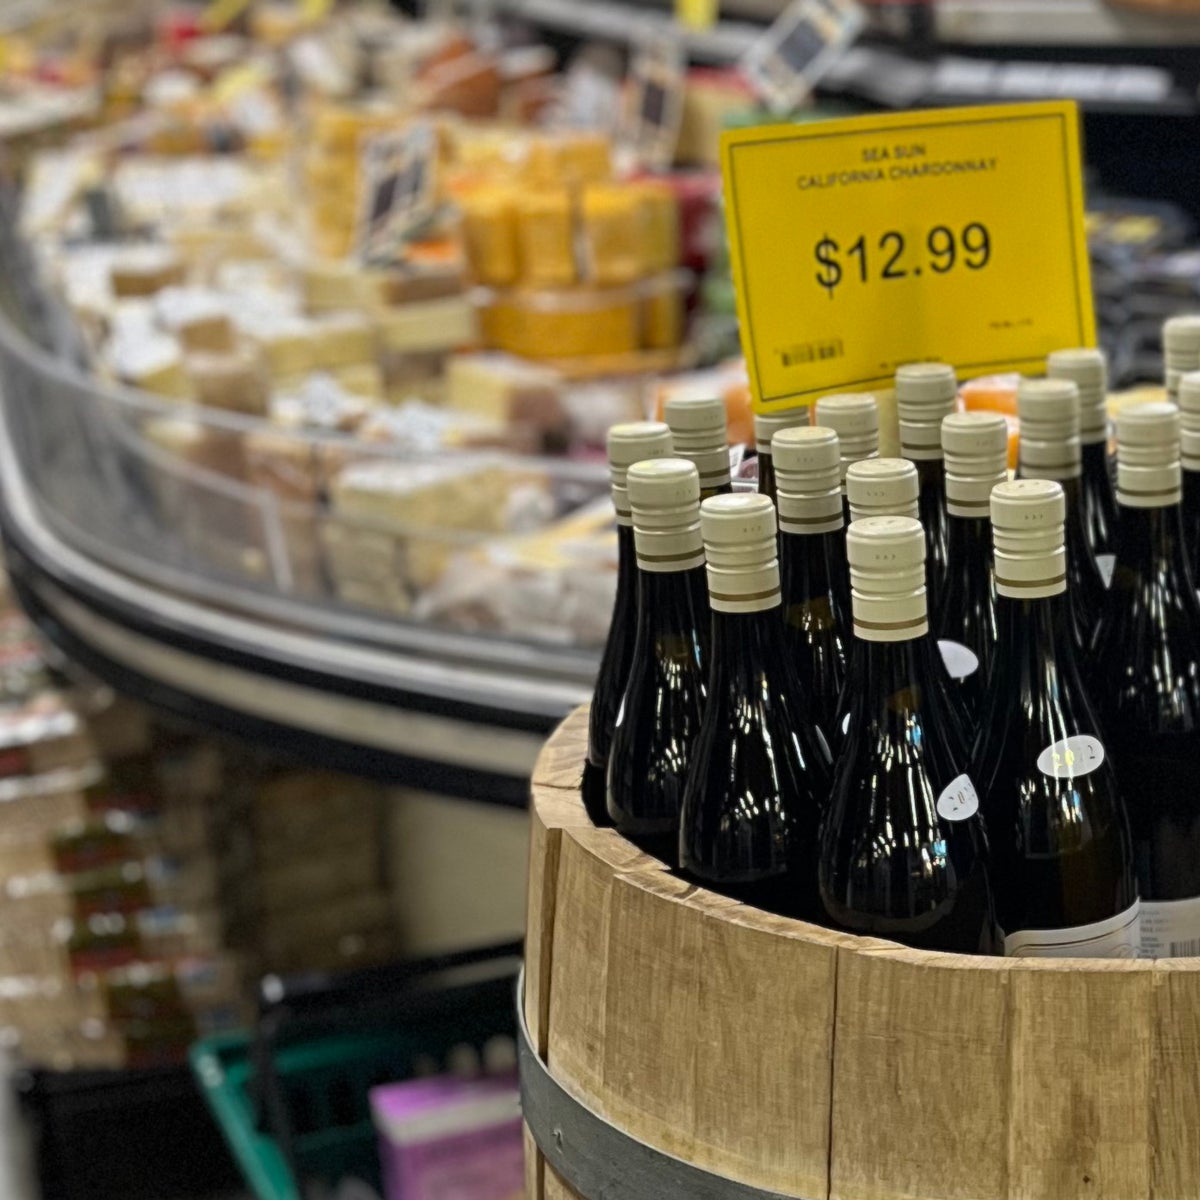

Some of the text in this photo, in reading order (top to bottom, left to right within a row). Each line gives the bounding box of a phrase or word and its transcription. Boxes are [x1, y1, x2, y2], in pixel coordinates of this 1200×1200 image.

[861, 143, 927, 163] SEA SUN
[797, 157, 998, 190] CALIFORNIA CHARDONNAY
[814, 221, 992, 300] $12.99
